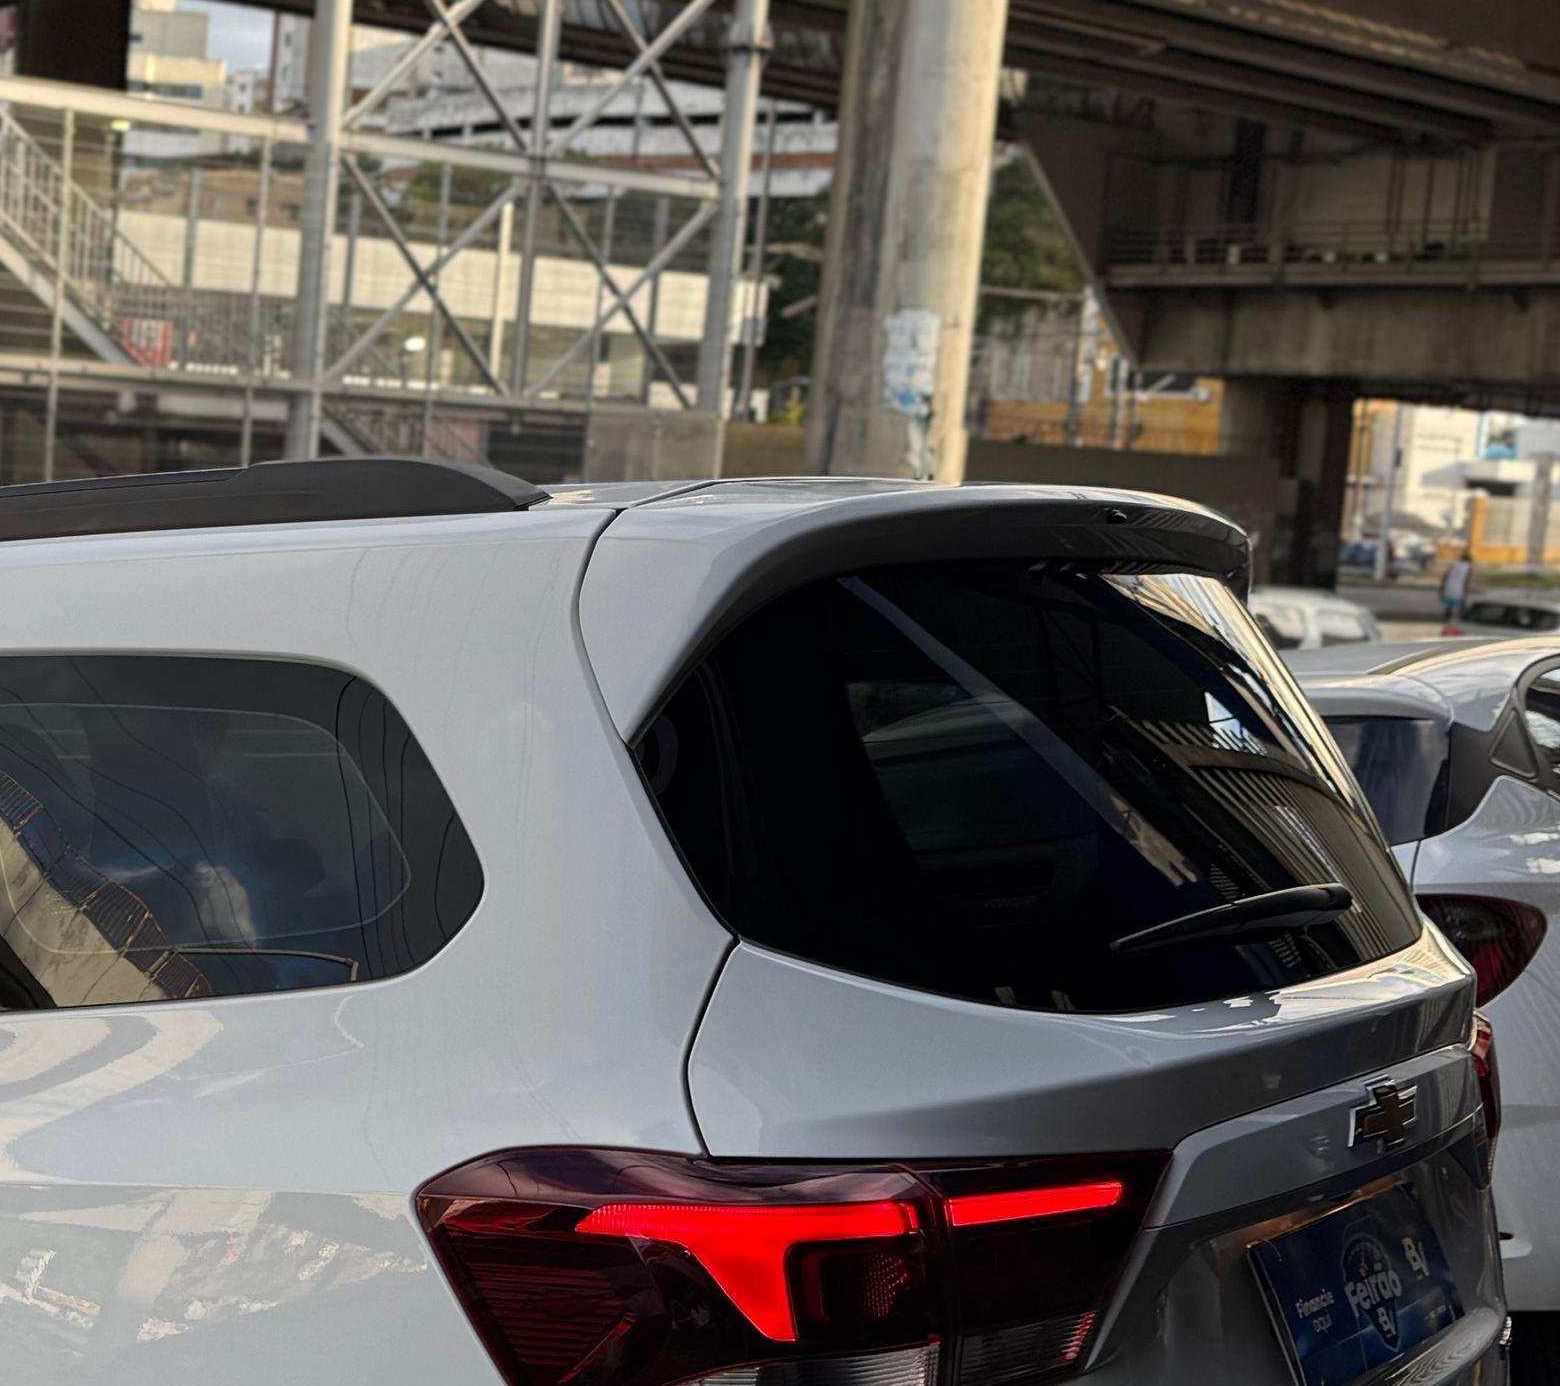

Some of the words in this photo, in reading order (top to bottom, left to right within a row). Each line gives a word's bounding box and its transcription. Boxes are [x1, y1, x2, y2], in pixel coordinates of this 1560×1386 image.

[1295, 1288, 1335, 1319] Financie
[1344, 1262, 1402, 1318] Feirão
[1312, 1313, 1333, 1334] aqui
